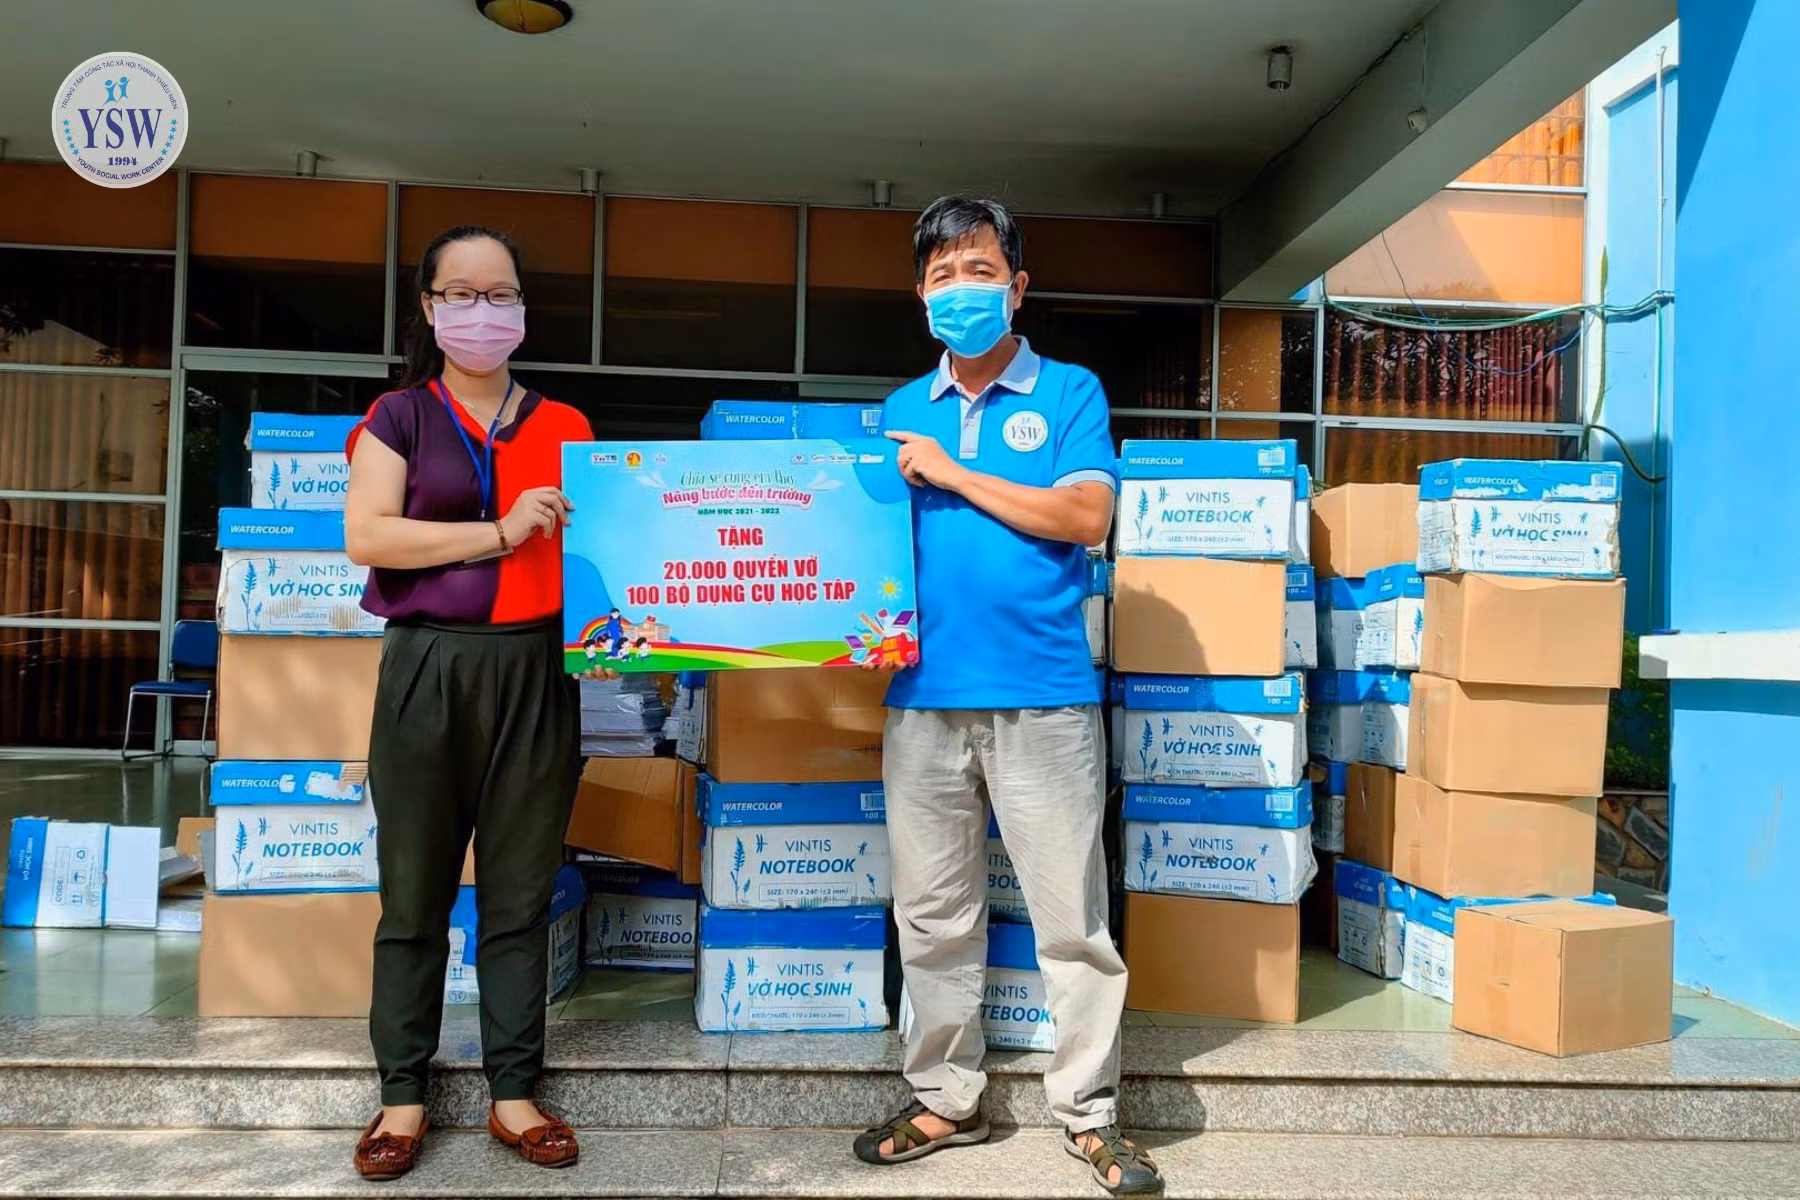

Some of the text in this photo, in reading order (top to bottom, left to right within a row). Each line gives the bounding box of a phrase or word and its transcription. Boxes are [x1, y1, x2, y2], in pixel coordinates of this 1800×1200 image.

[725, 415, 785, 425] WATERCOLOR
[257, 429, 315, 438] WATERCOLOR
[1011, 425, 1041, 440] YSW
[1128, 457, 1184, 465] WATERCOLOR
[318, 464, 350, 474] VINT
[291, 477, 314, 493] VỞ
[663, 483, 812, 505] Nâng bước đến trường
[1186, 491, 1230, 504] VINTIS
[1161, 509, 1254, 523] NOTEBOOK
[1518, 512, 1561, 524] VINTIS
[230, 525, 294, 534] WATERCOLOR
[717, 525, 764, 549] TẶNG
[300, 565, 349, 577] VINTIS
[664, 553, 818, 580] 20.000 QUYỂN VỞ
[269, 579, 367, 600] VỞ HỌC SIN
[627, 578, 855, 607] 100 BỘ DỤNG CỤ HỌC TẬP
[1133, 684, 1189, 694] WATERCOLOR
[1189, 725, 1235, 737] VINTIS
[1163, 738, 1263, 758] VỞ HỌC SINH
[221, 779, 280, 788] WATERCOLO
[722, 802, 783, 811] WATERCOLOR
[1135, 795, 1192, 806] WATERCOLOR
[864, 812, 878, 820] 100
[289, 823, 339, 836] VINTIS
[262, 842, 364, 858] NOTEBOOK
[785, 839, 832, 852] VINTIS
[1189, 837, 1234, 850] VINTIS
[759, 858, 855, 875] NOTEBOOK
[1166, 853, 1257, 872] NOTEBOOK
[642, 913, 683, 926] VINTIS
[621, 930, 693, 944] NOTEBOO
[777, 963, 824, 976] VINTIS
[748, 979, 853, 1000] VỞ HỌC SINH
[980, 1004, 1050, 1023] TEBOOK
